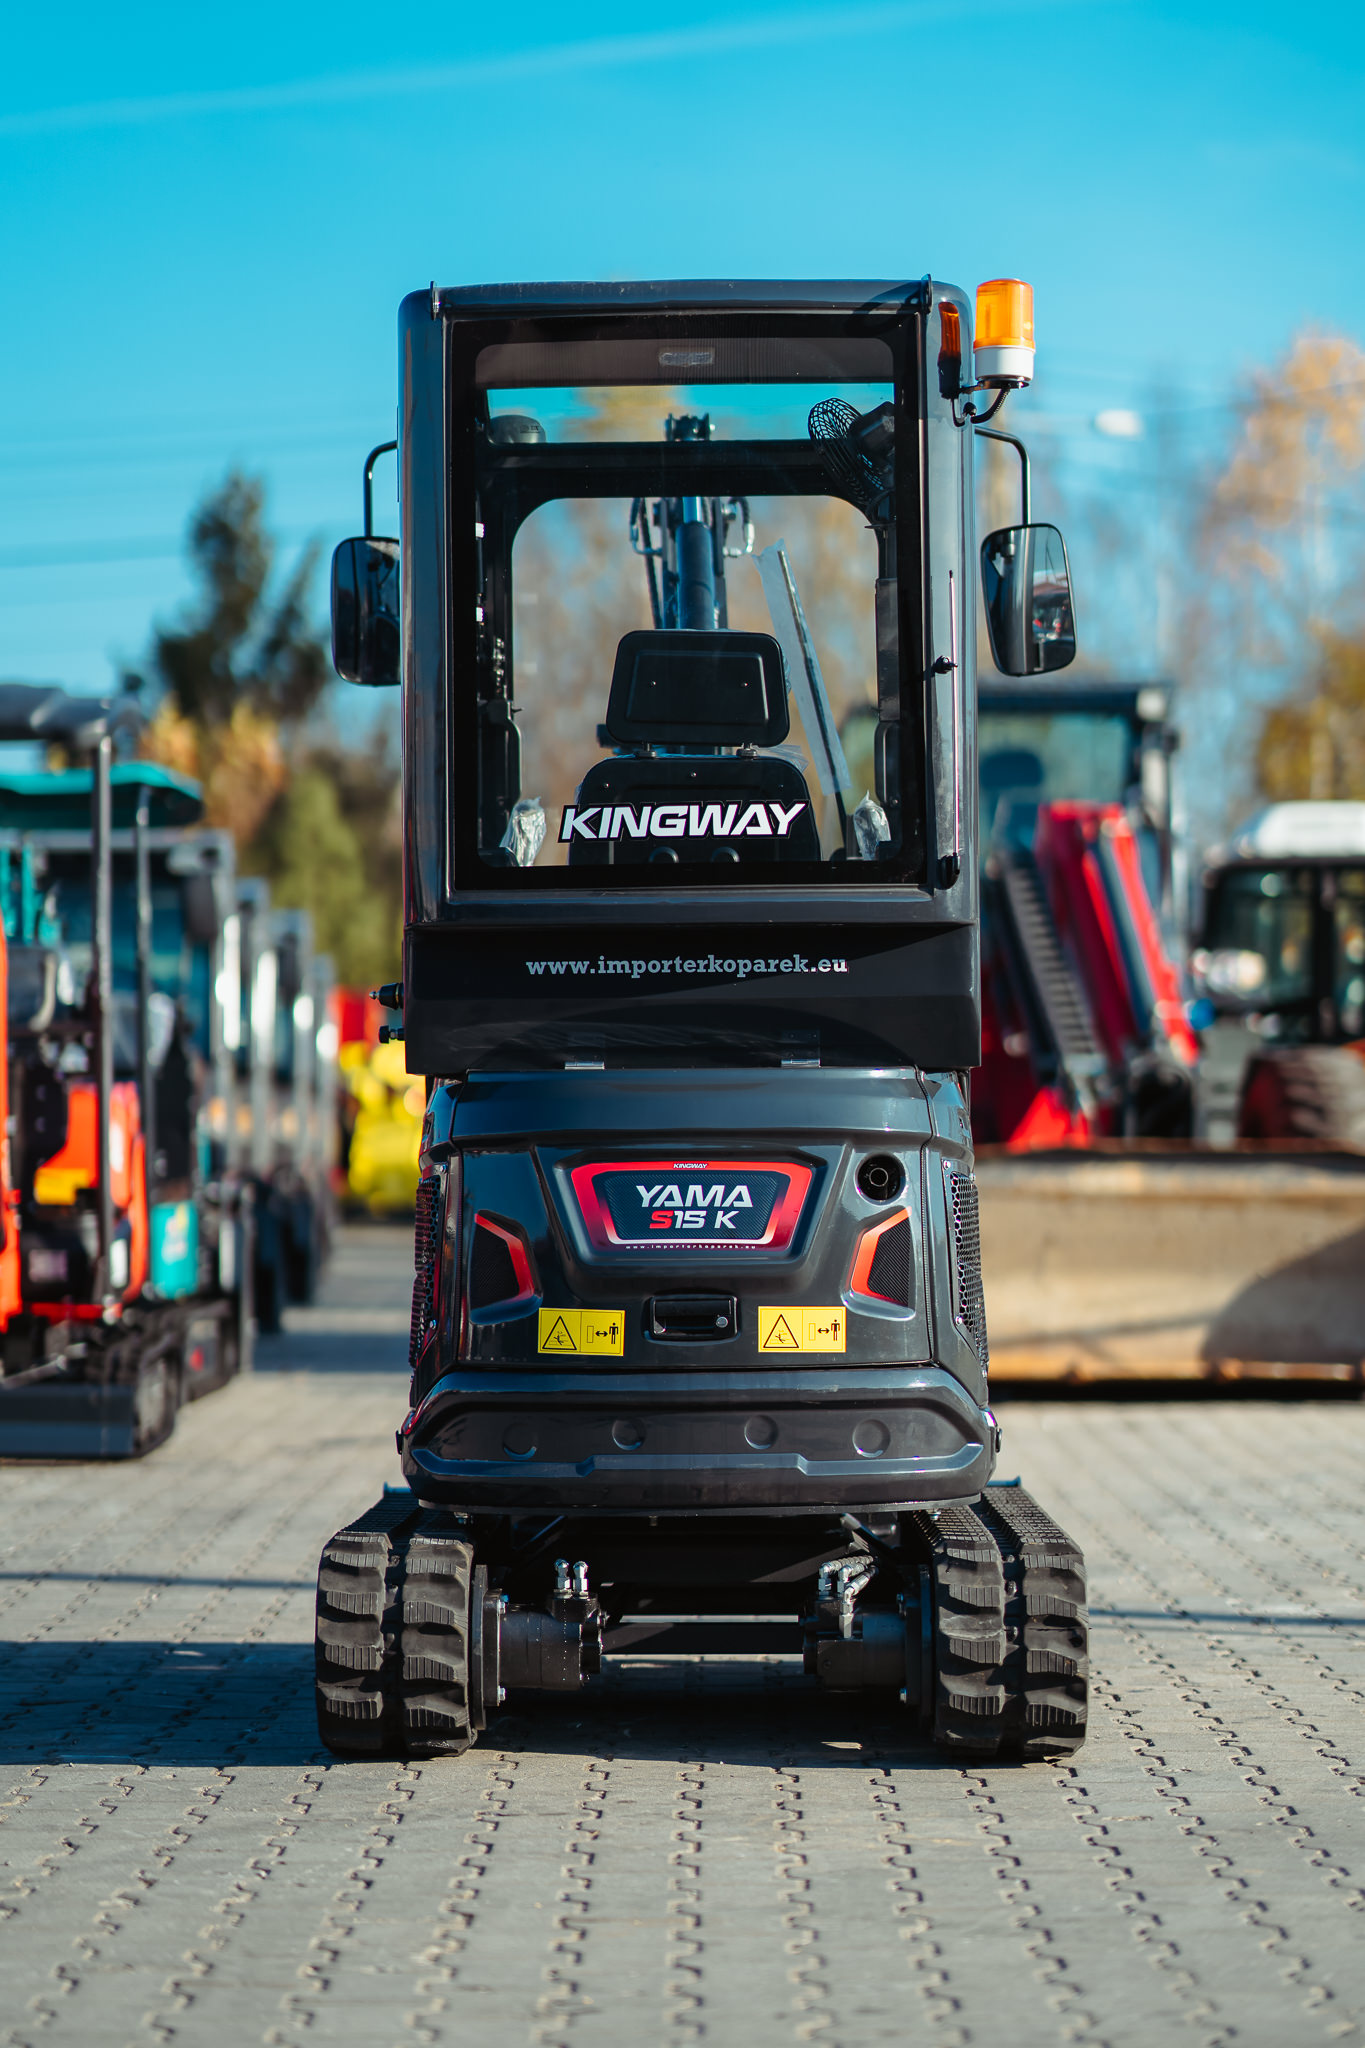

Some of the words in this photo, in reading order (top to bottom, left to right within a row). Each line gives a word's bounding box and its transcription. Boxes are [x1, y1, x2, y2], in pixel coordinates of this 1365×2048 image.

[561, 803, 806, 840] KINGWAY
[525, 954, 848, 979] www.importerkoparek.eu
[636, 1185, 753, 1207] YAMA
[649, 1210, 707, 1229] S15
[714, 1210, 740, 1229] K
